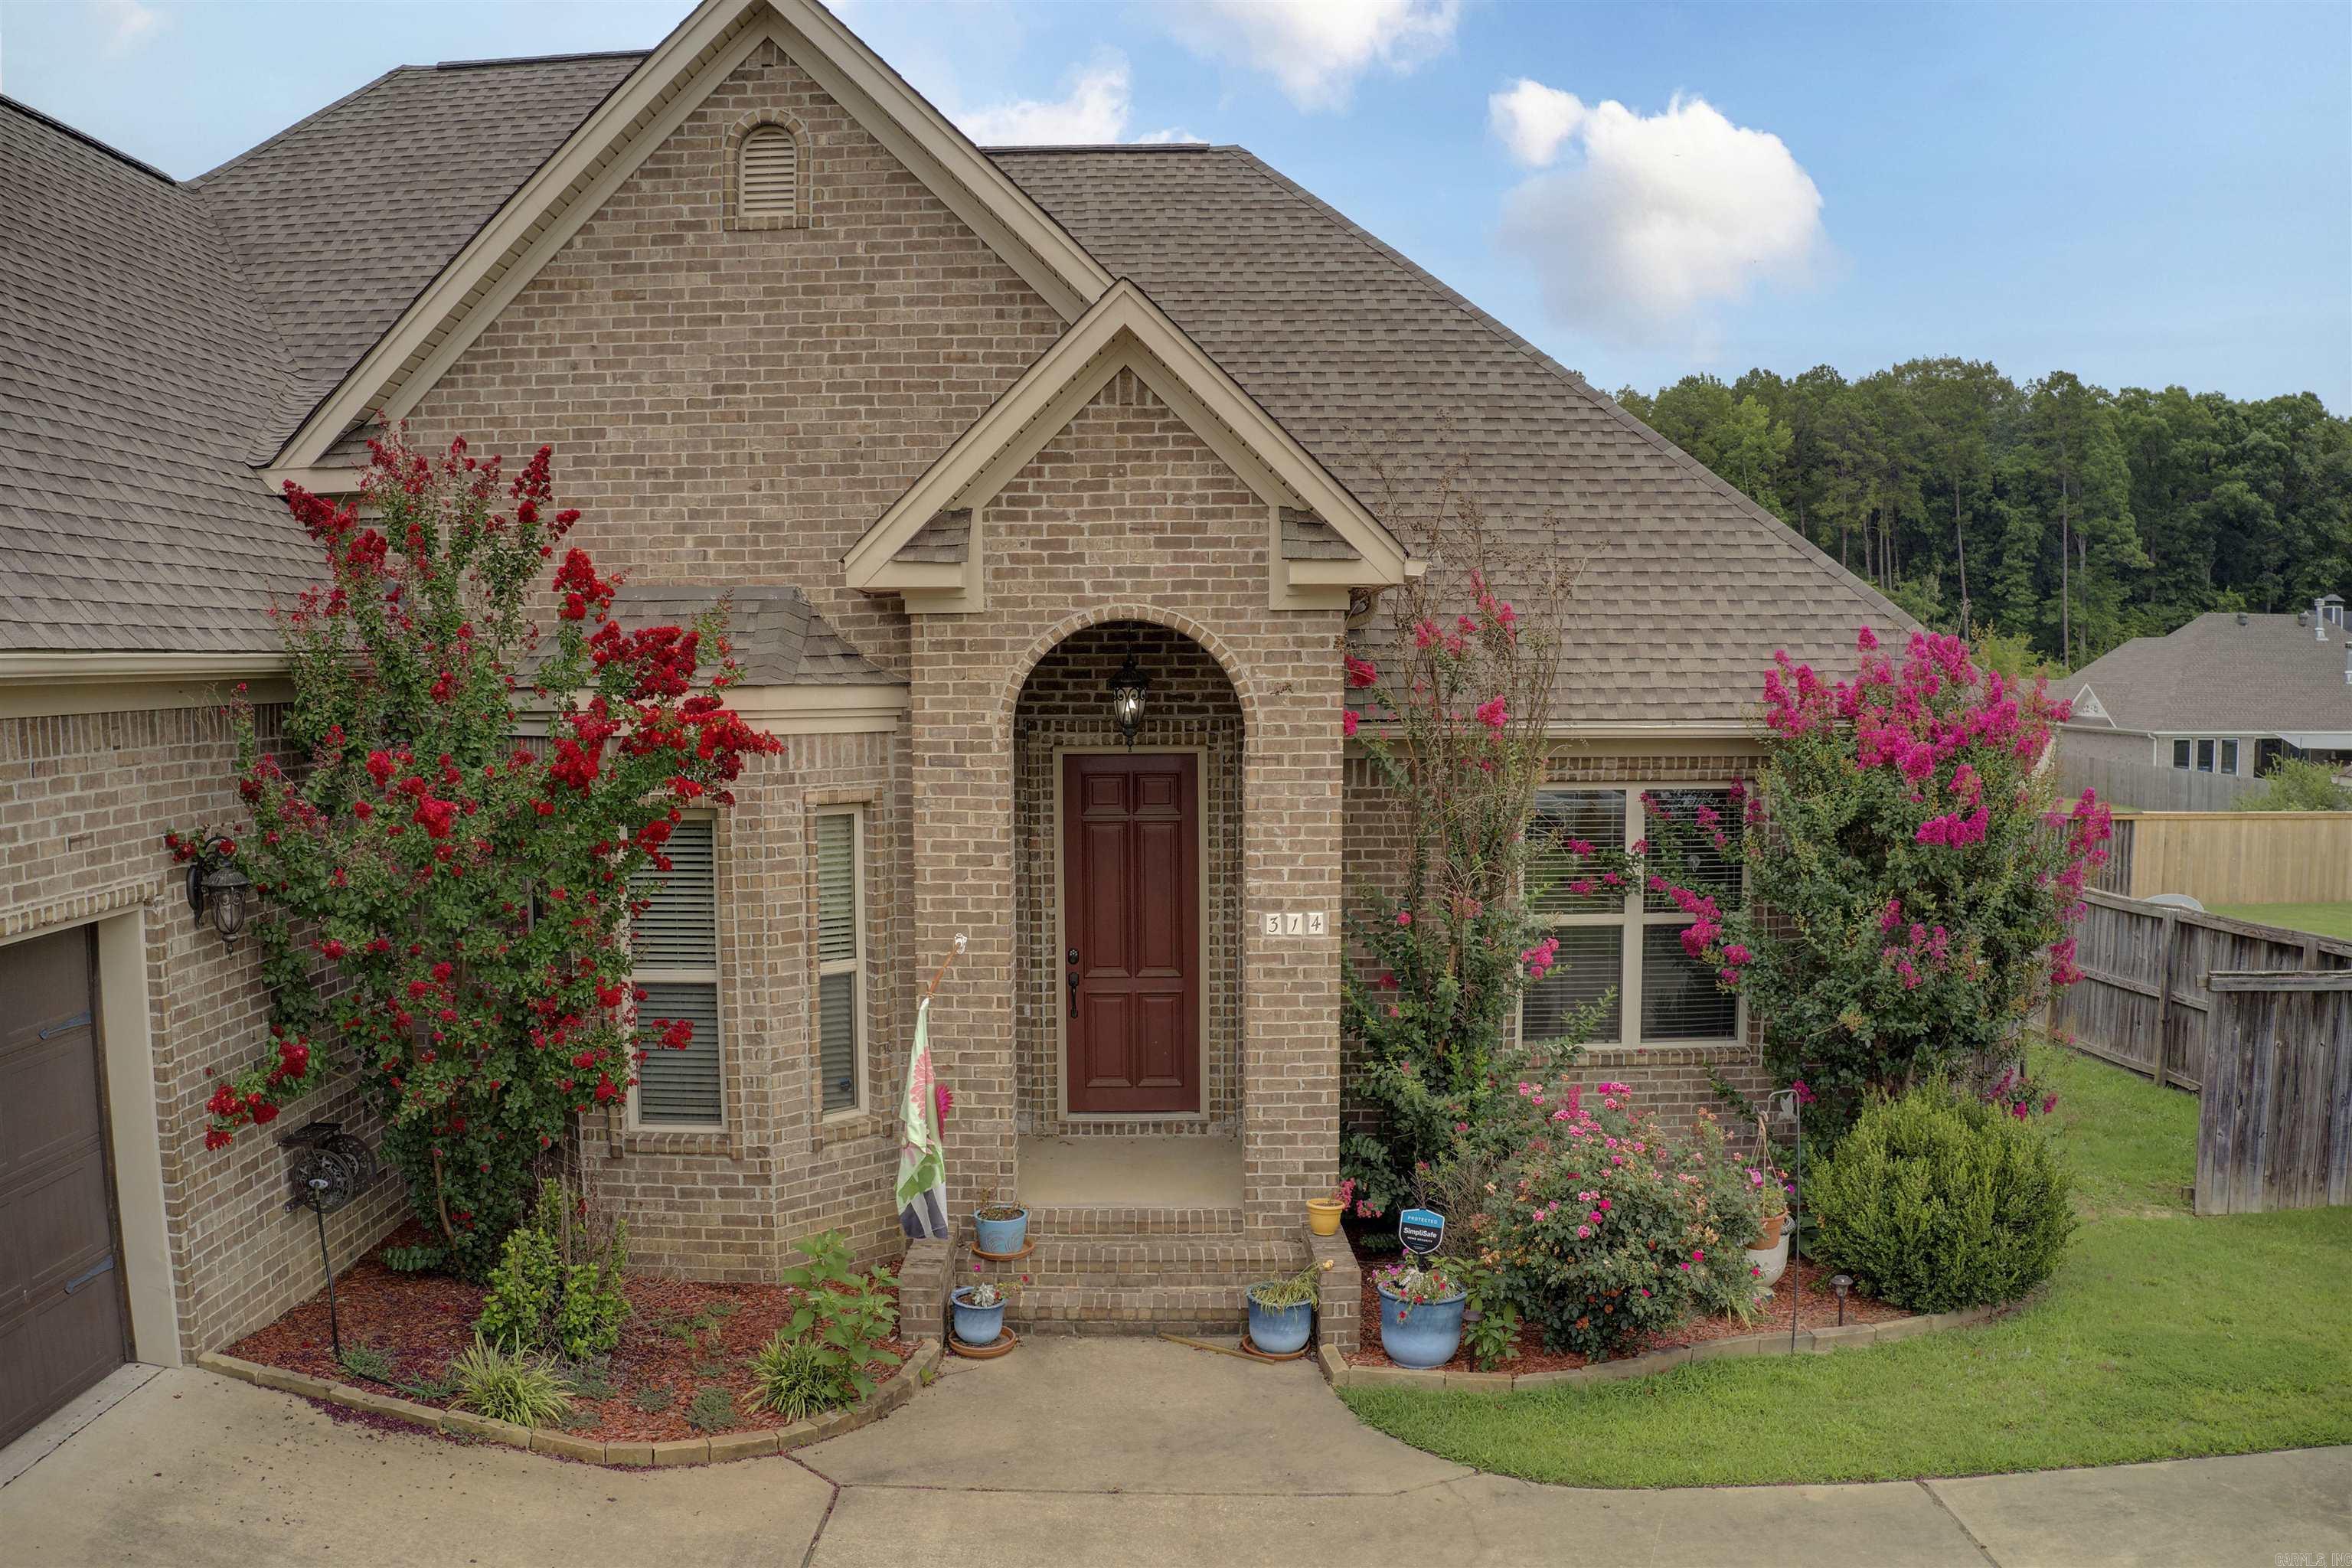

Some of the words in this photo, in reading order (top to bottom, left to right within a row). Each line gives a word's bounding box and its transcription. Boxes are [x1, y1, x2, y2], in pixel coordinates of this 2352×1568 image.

[1268, 916, 1321, 932] 314
[1407, 1216, 1438, 1224] PROTECTED
[1403, 1227, 1437, 1238] SimpliSafe
